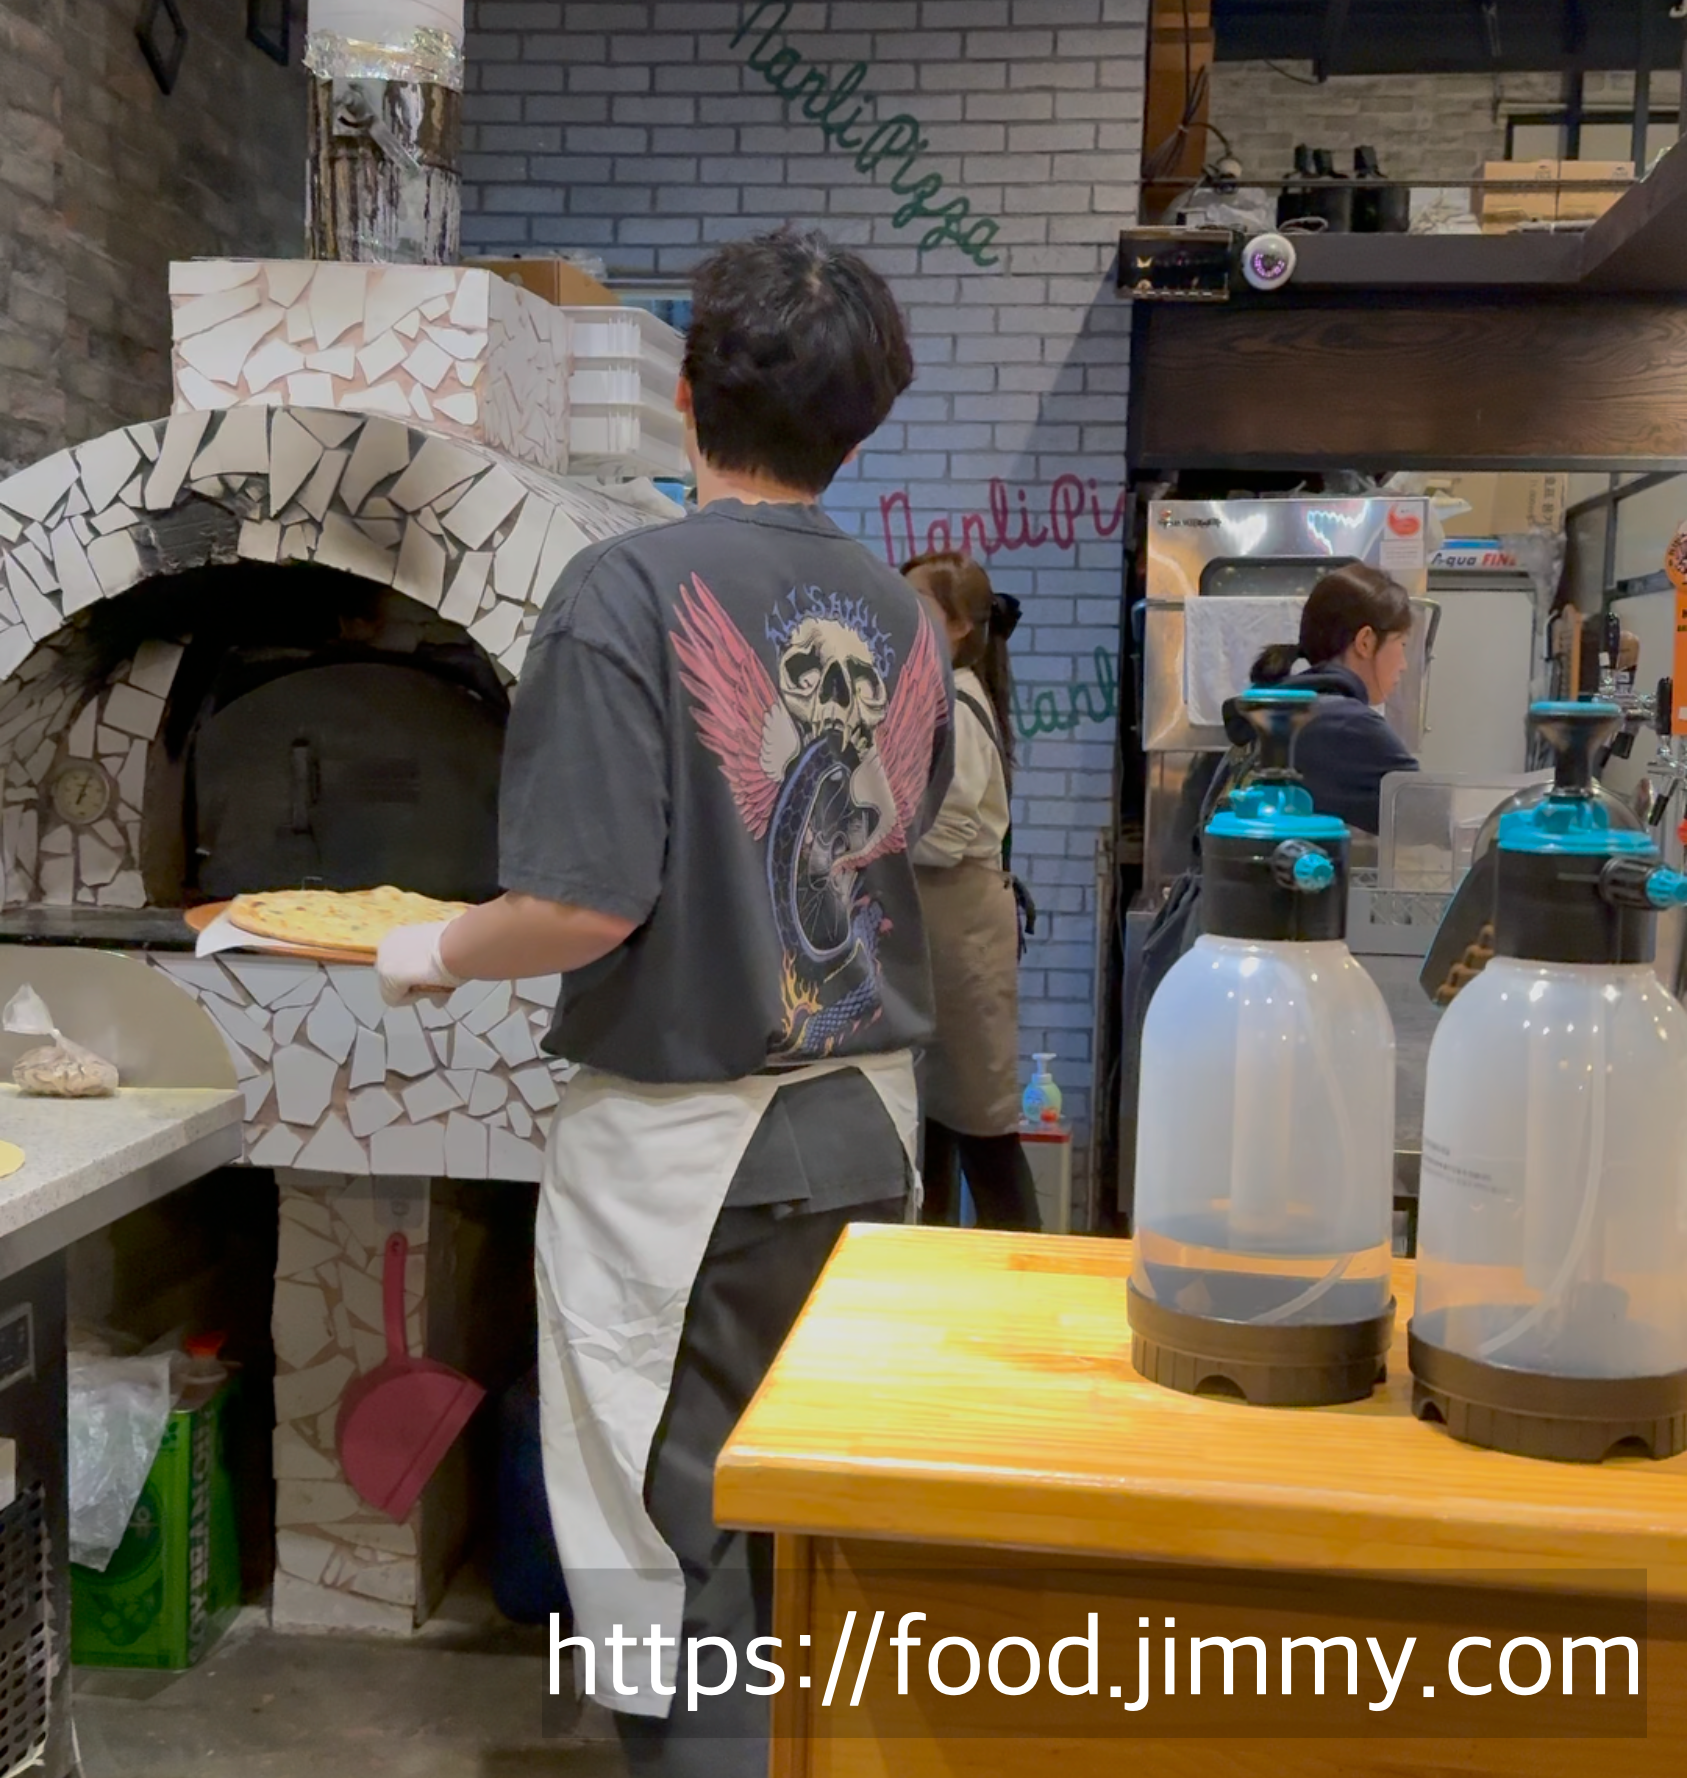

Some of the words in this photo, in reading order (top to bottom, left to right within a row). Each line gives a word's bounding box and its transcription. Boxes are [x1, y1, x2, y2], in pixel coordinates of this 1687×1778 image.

[854, 114, 998, 266] Pizza
[1052, 474, 1126, 549] Pi
[1431, 552, 1478, 567] Aqua
